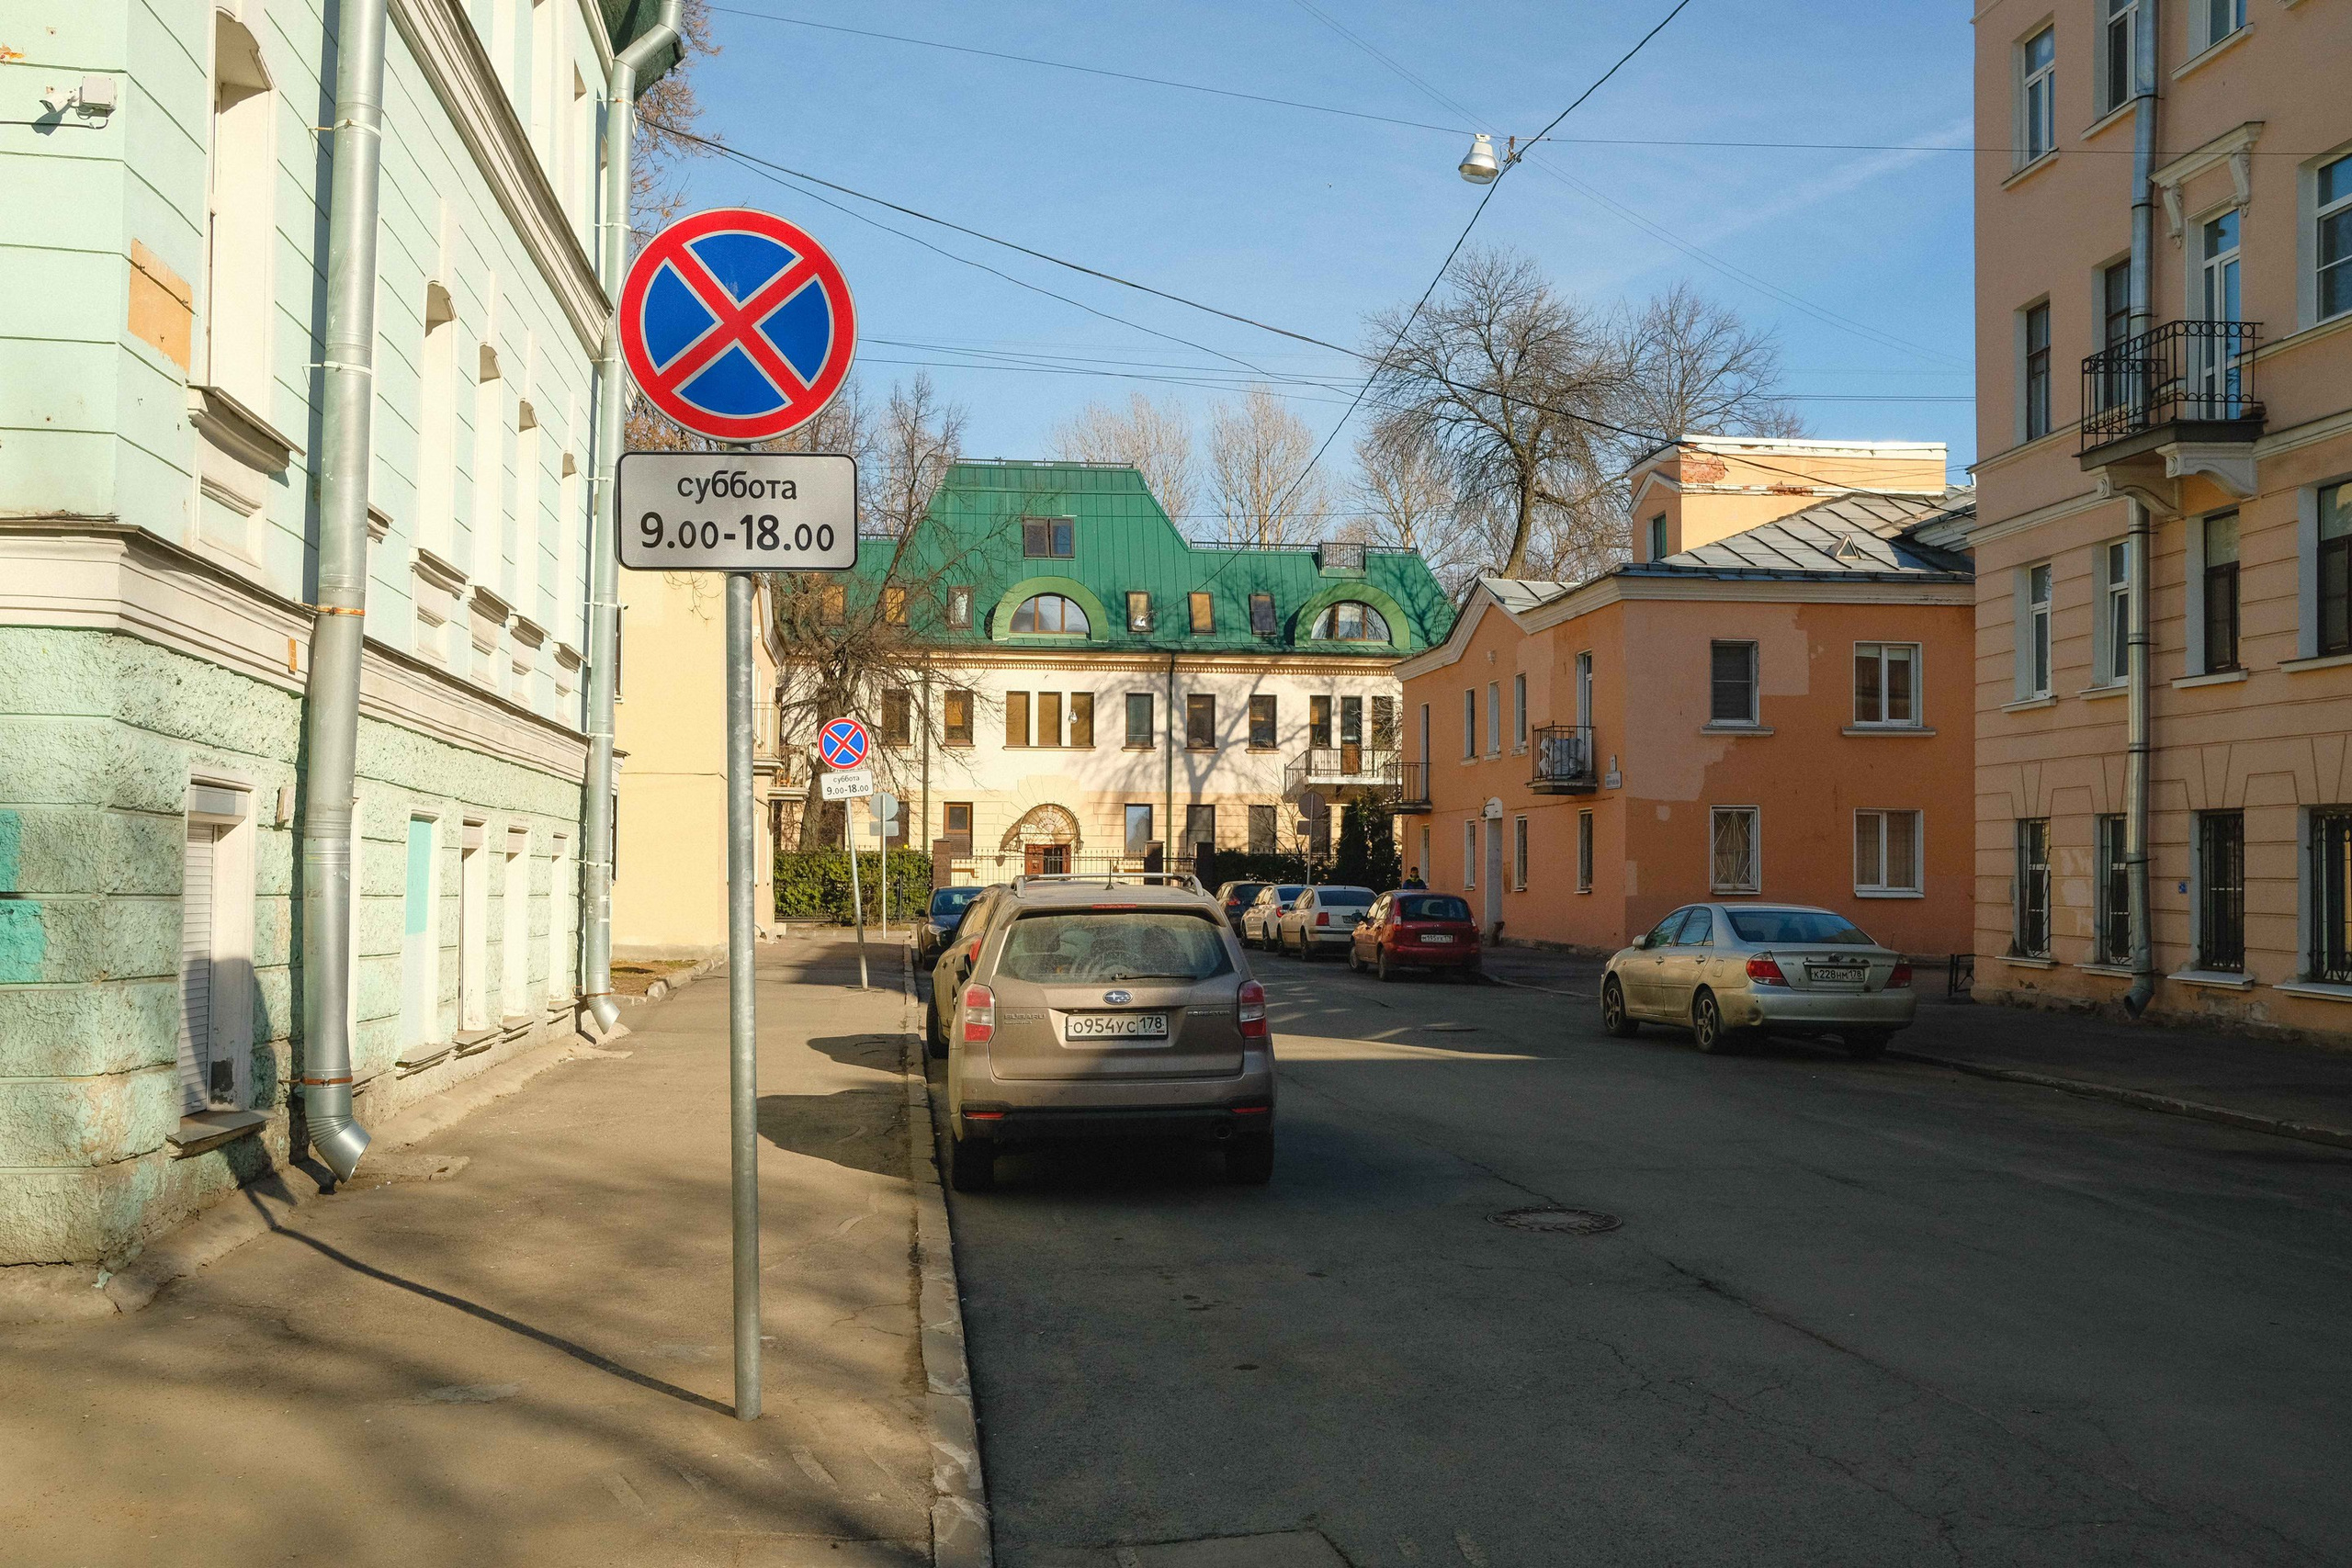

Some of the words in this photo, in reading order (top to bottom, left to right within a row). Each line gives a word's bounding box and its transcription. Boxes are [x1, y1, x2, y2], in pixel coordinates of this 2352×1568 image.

[677, 469, 797, 504] суббота
[640, 511, 835, 551] 9.00-18.00
[832, 775, 860, 784] суббота
[826, 784, 869, 795] 9.00-18.00
[1139, 1016, 1162, 1029] 178
